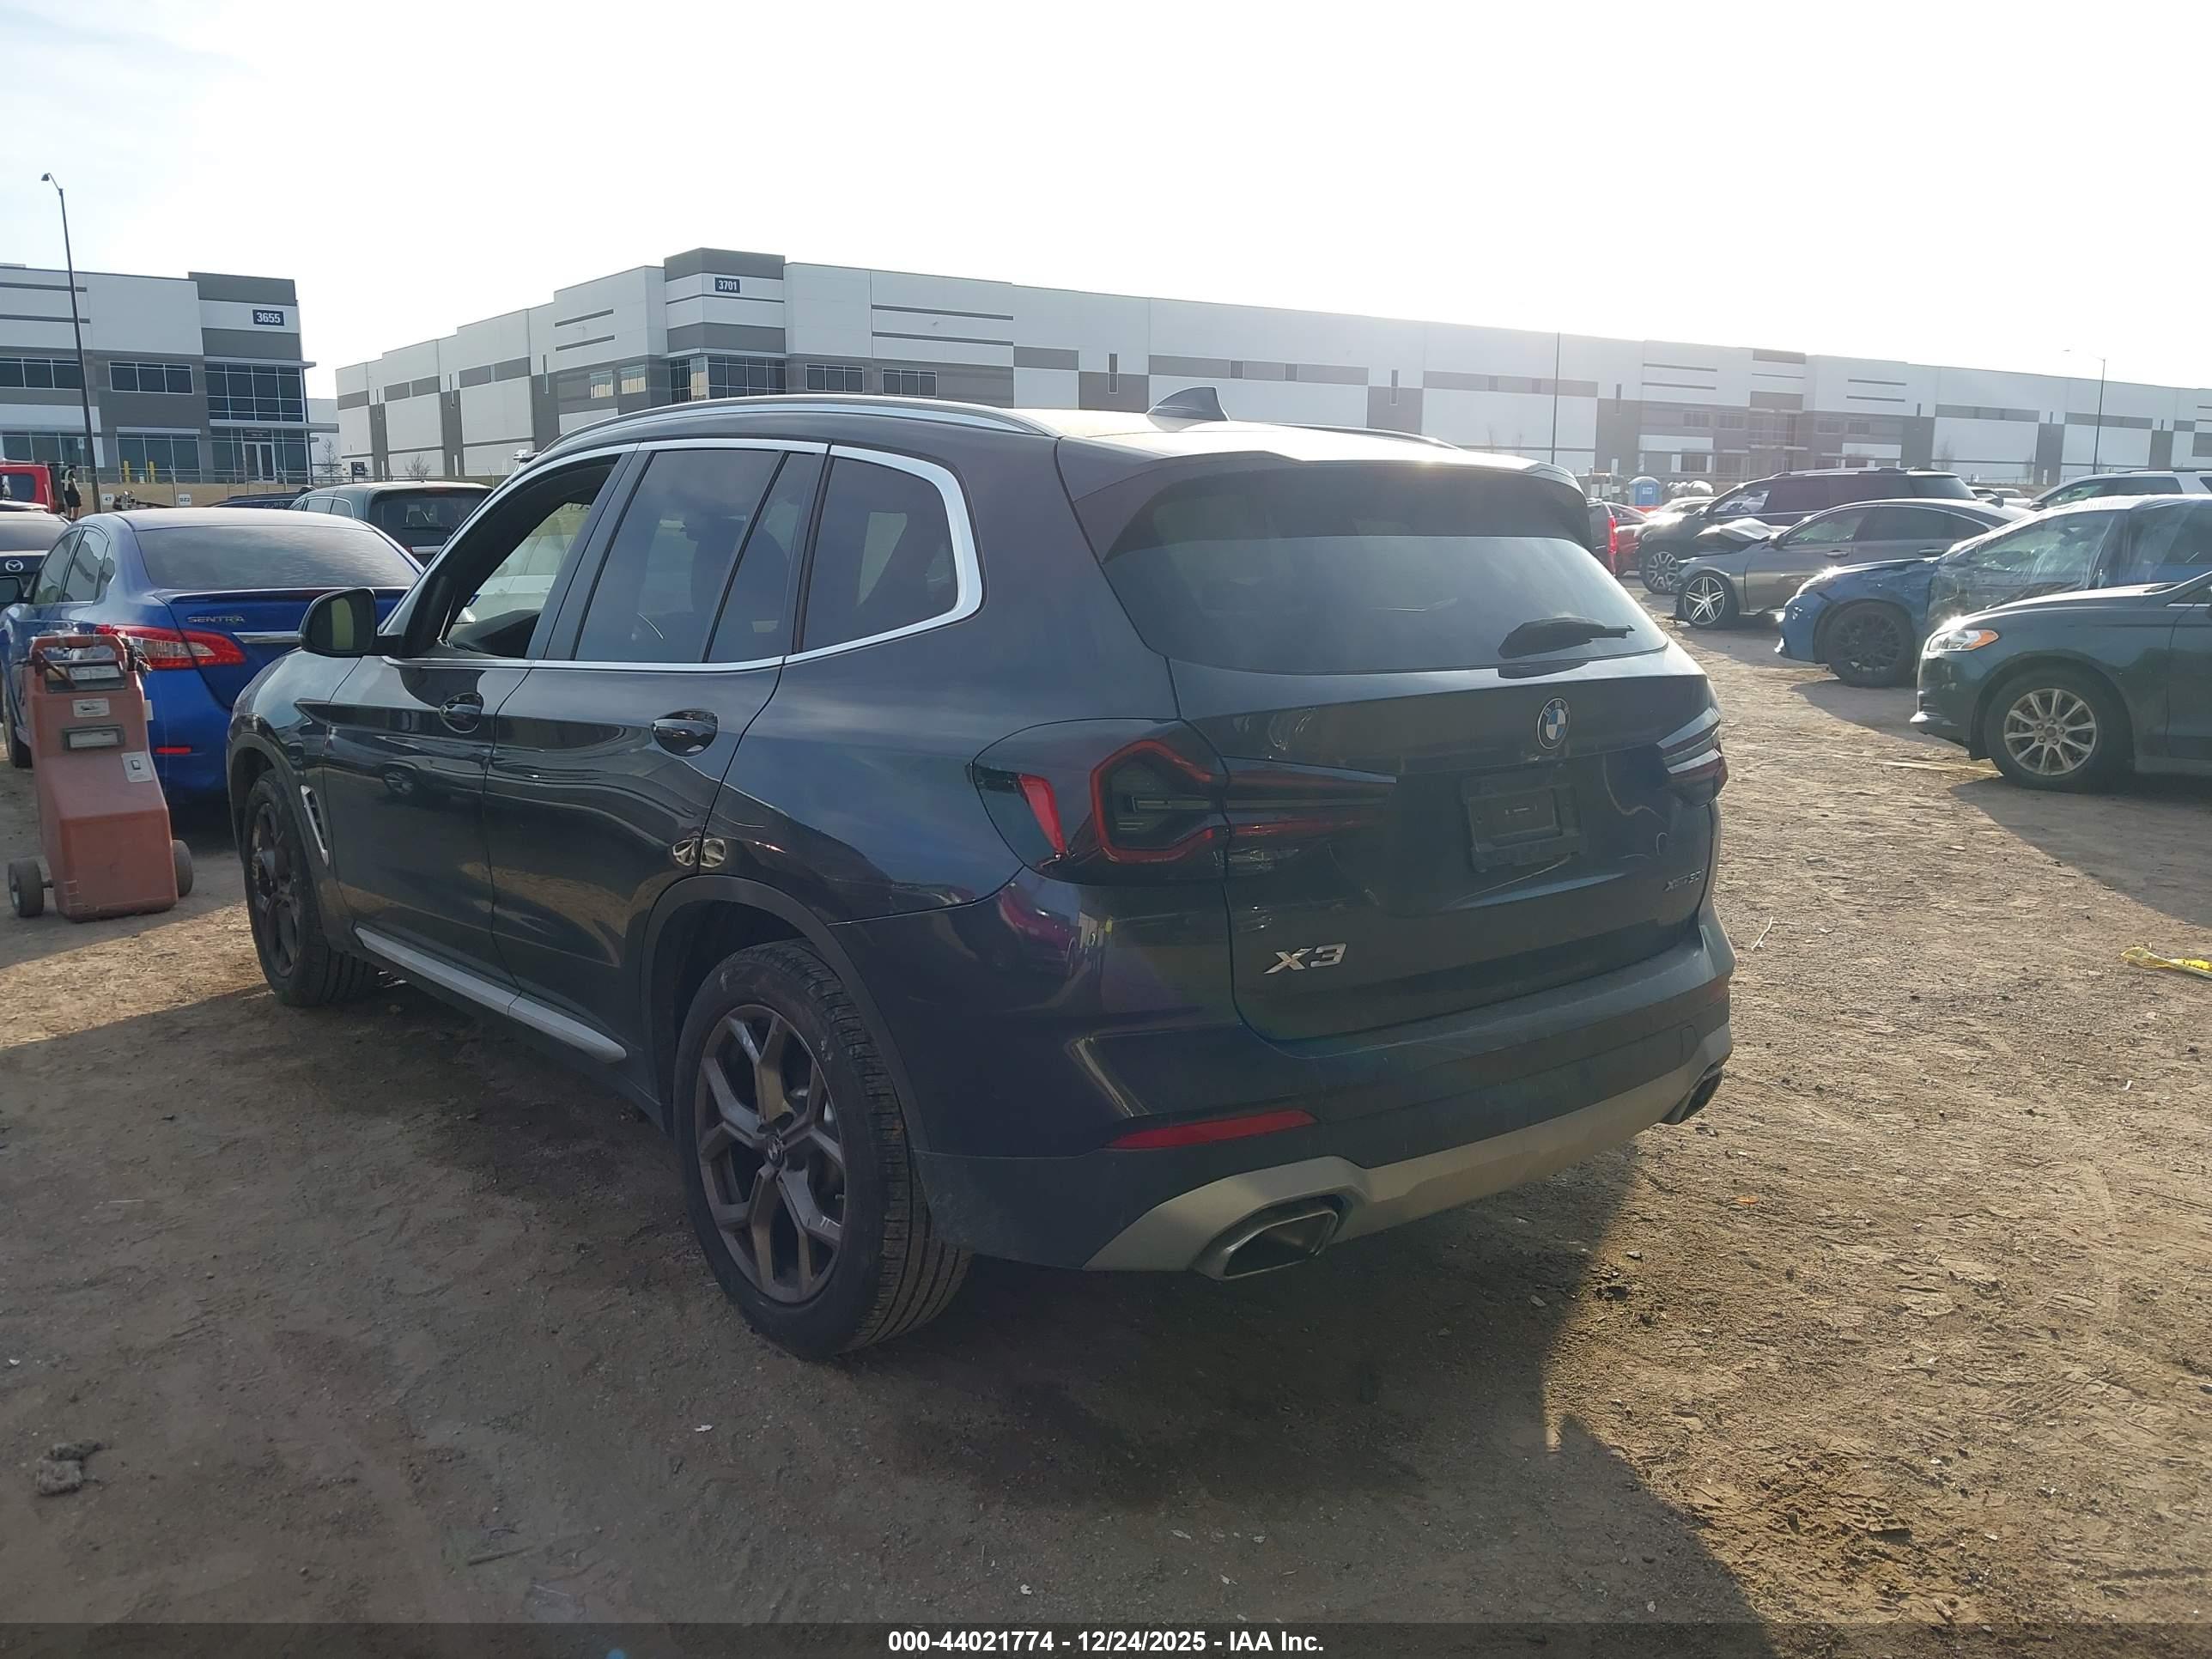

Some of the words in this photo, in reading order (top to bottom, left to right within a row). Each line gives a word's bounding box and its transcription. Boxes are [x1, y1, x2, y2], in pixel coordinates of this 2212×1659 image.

[718, 280, 737, 290] 3701
[257, 312, 281, 324] 3655
[186, 616, 246, 624] SENTRA
[1264, 943, 1346, 975] X3
